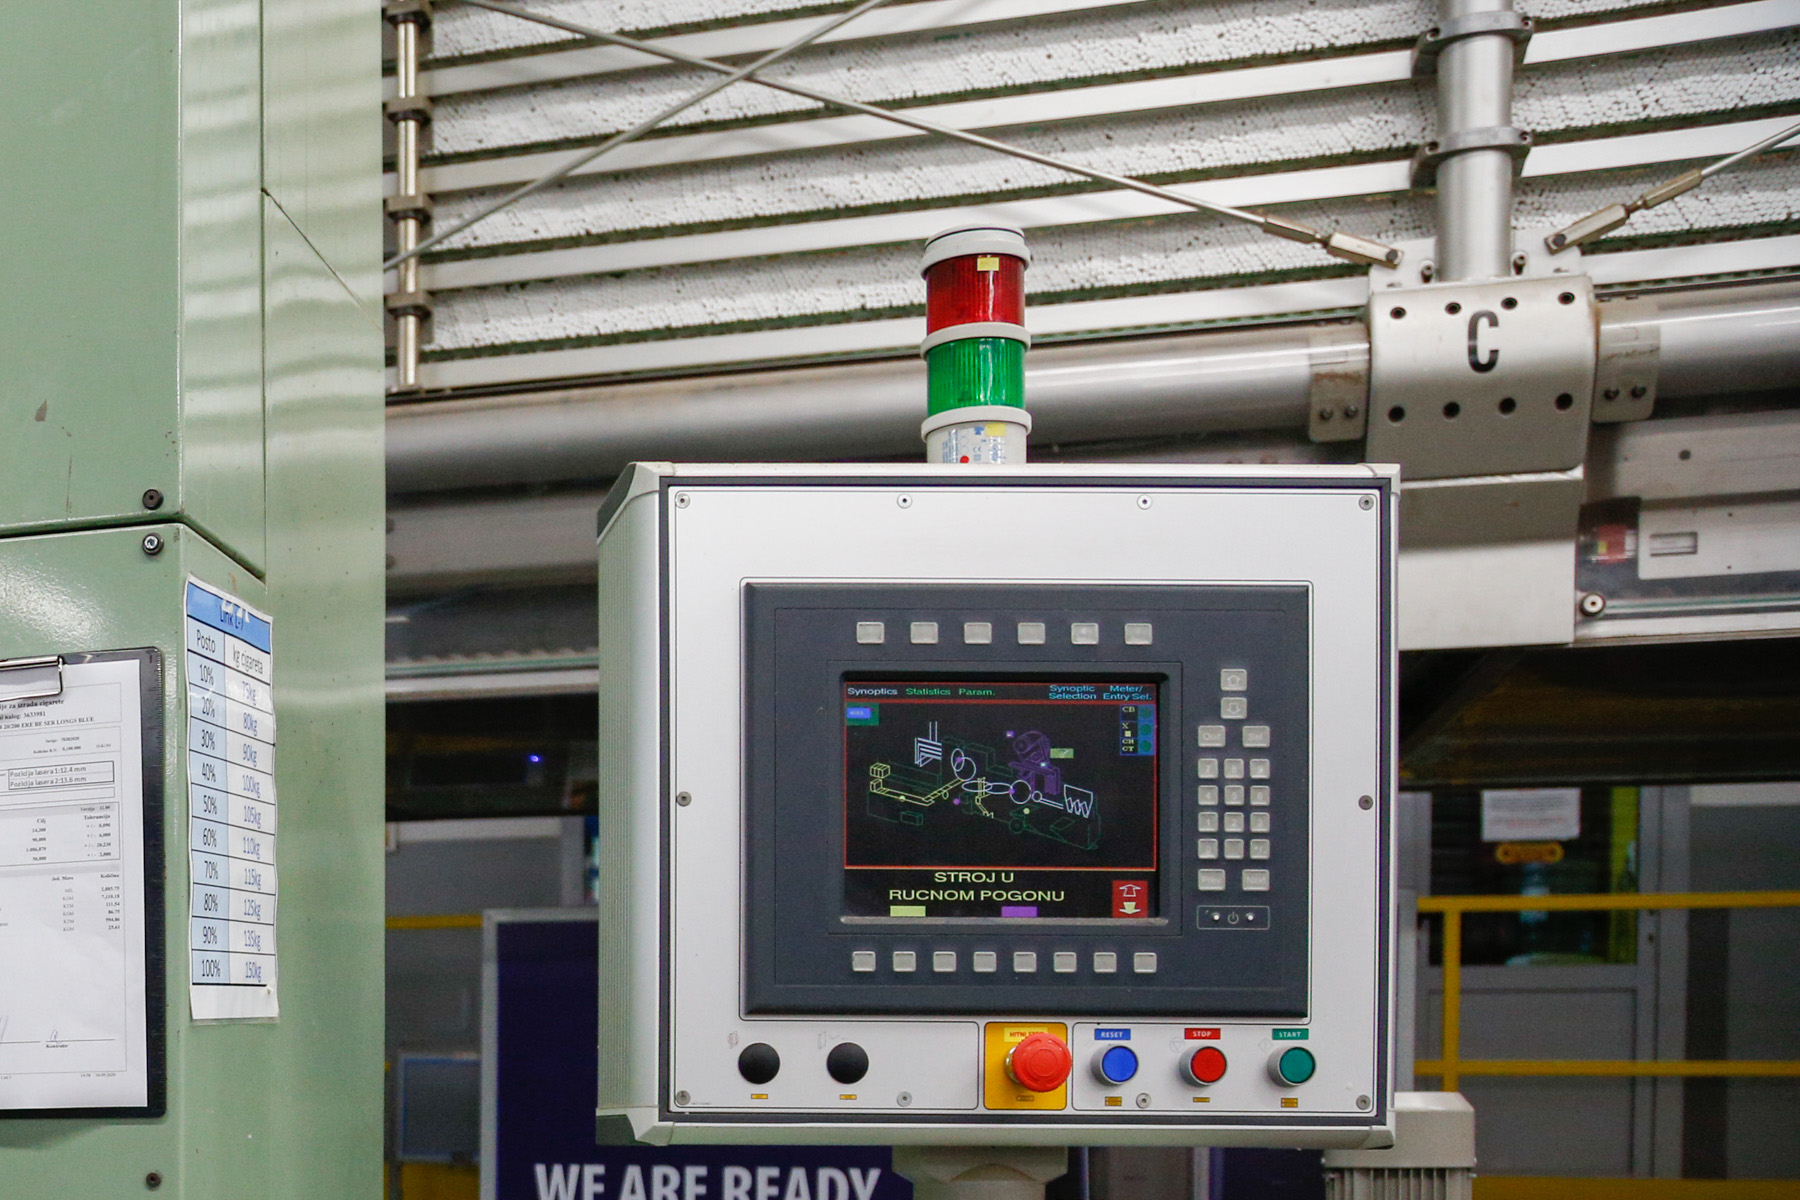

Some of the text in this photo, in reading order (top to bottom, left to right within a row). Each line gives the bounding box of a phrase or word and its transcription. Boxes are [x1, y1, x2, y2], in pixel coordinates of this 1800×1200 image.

[1467, 310, 1499, 374] C
[196, 629, 216, 653] Posto
[233, 644, 263, 675] kg cigareta
[200, 664, 214, 686] 10%
[242, 681, 256, 706] 75kg
[847, 687, 898, 697] Synoptics
[906, 687, 951, 696] Statistics
[958, 688, 995, 696] Param.
[1049, 685, 1095, 693] Synoptic
[1049, 692, 1096, 700] Selection
[1103, 692, 1132, 701] Entry
[1109, 685, 1143, 693] Meter/
[202, 696, 215, 718] 20%
[243, 712, 258, 736] 80kg
[201, 729, 215, 751] 30%
[242, 743, 257, 767] 90kg
[10, 769, 34, 778] Pozicija
[10, 779, 34, 788] Pozicija
[35, 778, 54, 786] lasera
[202, 762, 216, 783] 40%
[242, 775, 261, 799] 100kg
[203, 794, 217, 815] 50%
[244, 805, 261, 830] 105kg
[203, 828, 217, 848] 60%
[243, 836, 261, 860] 110kg
[204, 860, 218, 880] 70%
[245, 868, 261, 891] 115kg
[934, 871, 1014, 883] STROJ U
[204, 893, 218, 912] 80%
[889, 889, 1065, 901] RUCNOM POGONU
[244, 899, 261, 921] 125kg
[203, 926, 217, 945] 90%
[244, 930, 261, 952] 135kg
[201, 958, 221, 978] 100%
[245, 961, 261, 983] 150kg
[1192, 1030, 1212, 1038] STOP
